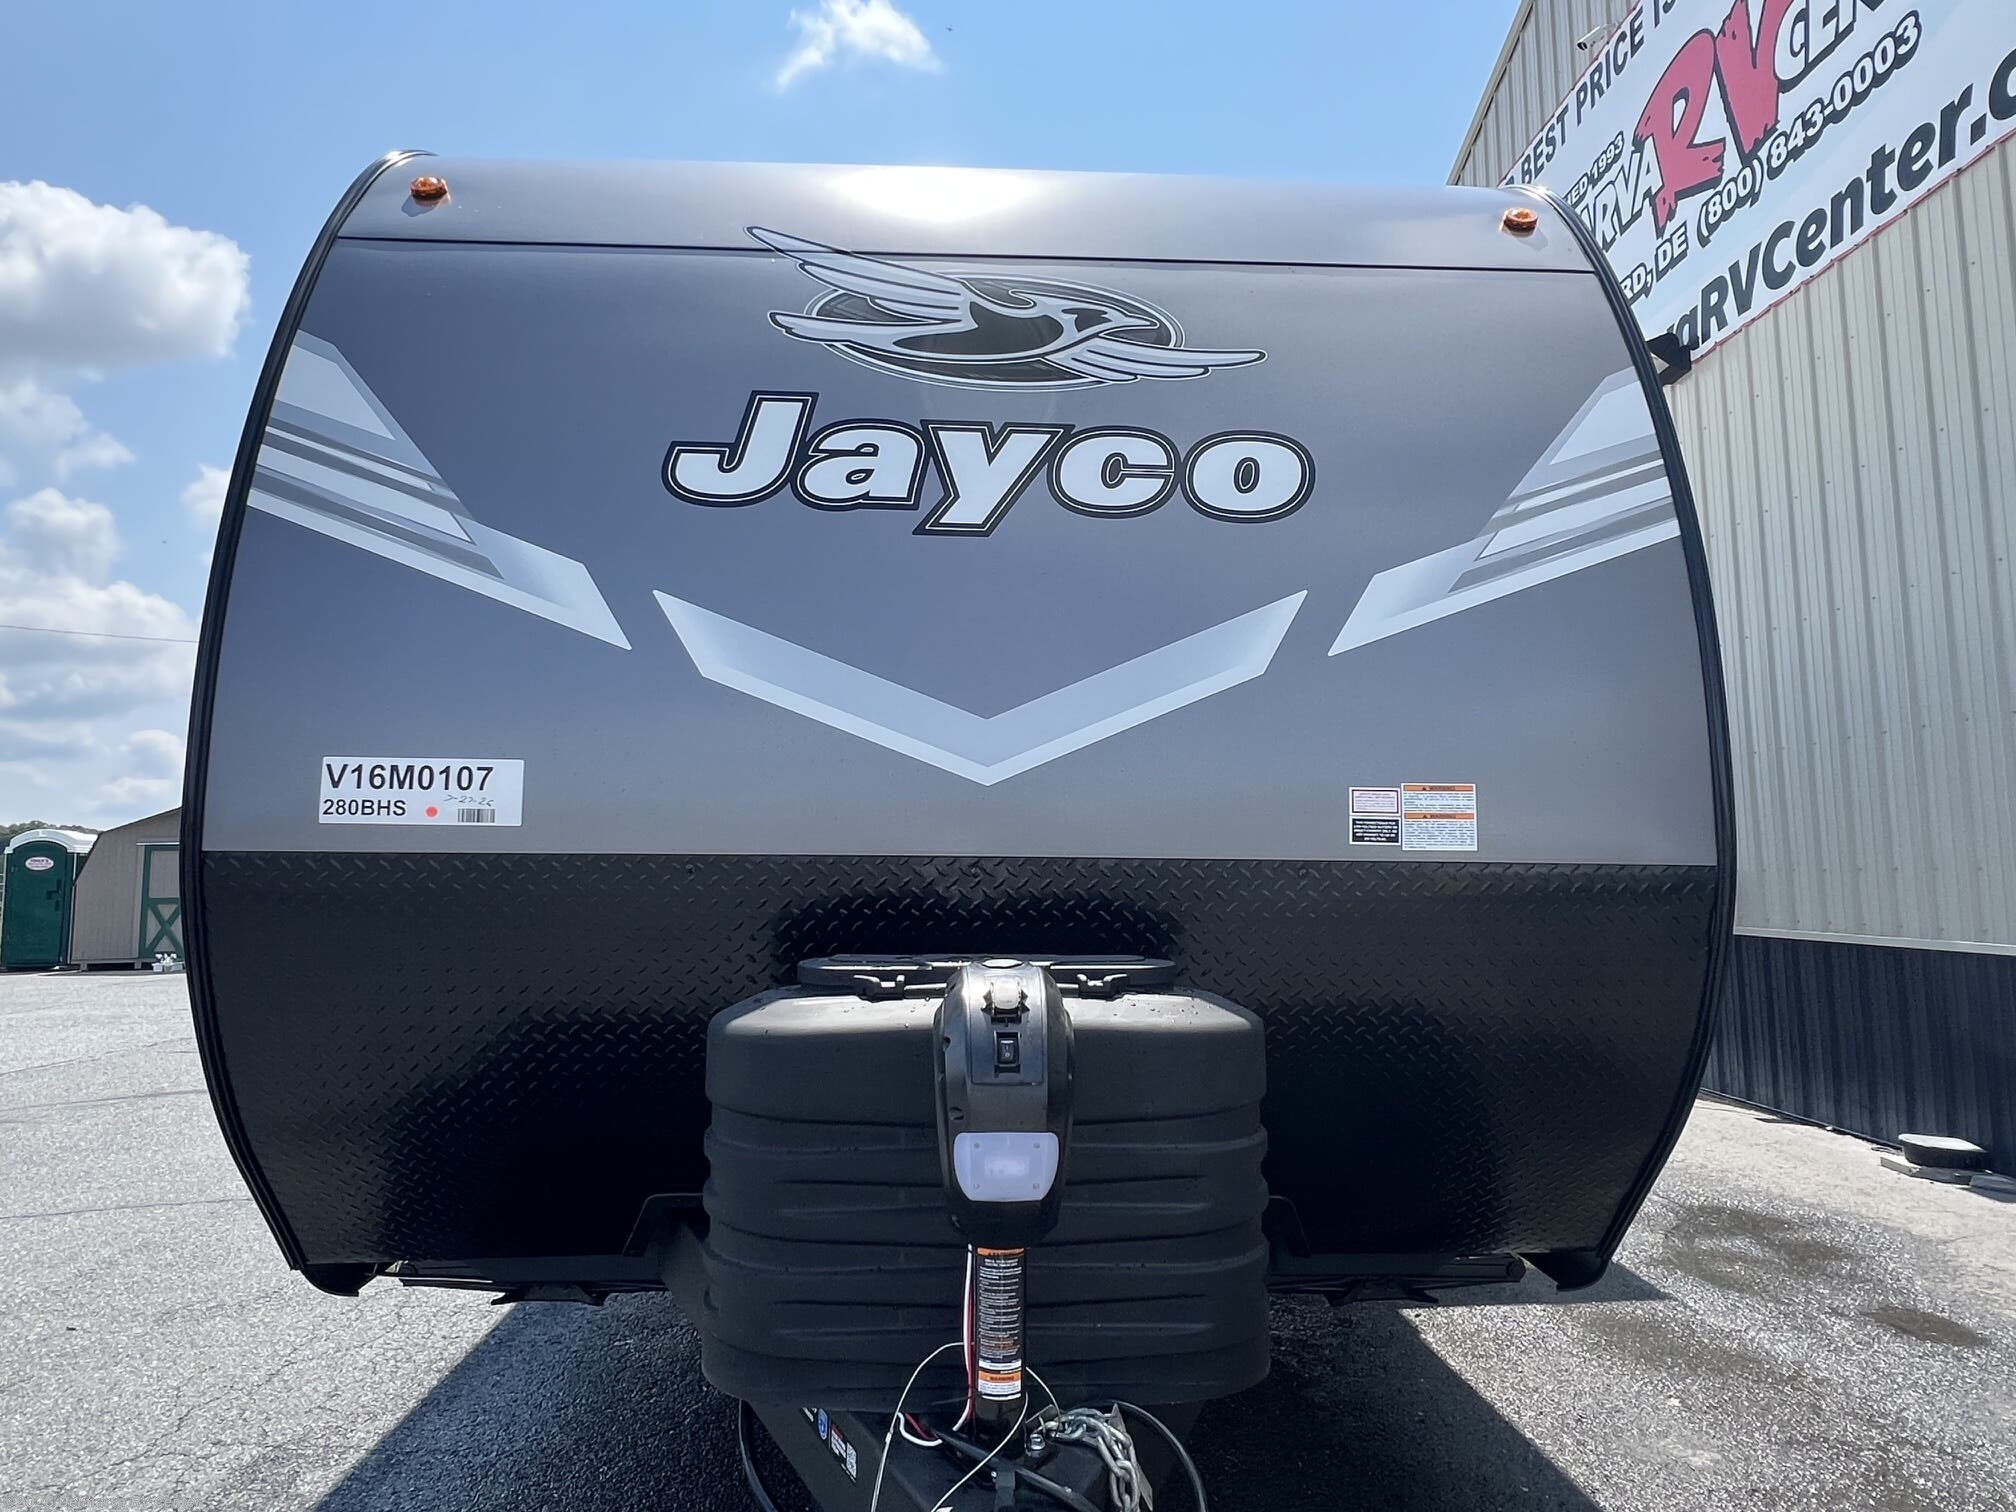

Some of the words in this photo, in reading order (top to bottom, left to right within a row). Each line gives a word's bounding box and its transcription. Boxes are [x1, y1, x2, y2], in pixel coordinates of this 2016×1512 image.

[1521, 104, 1570, 185] BEST
[1576, 5, 1645, 127] PRICE
[1653, 0, 1676, 28] I
[1589, 131, 1625, 186] 1993
[1655, 221, 1690, 281] DE
[1697, 155, 1764, 247] (800)
[1766, 10, 1922, 181] 843-0003
[662, 391, 1315, 537] Jayco
[322, 799, 407, 817] 280BHS
[325, 763, 494, 791] V16M0107
